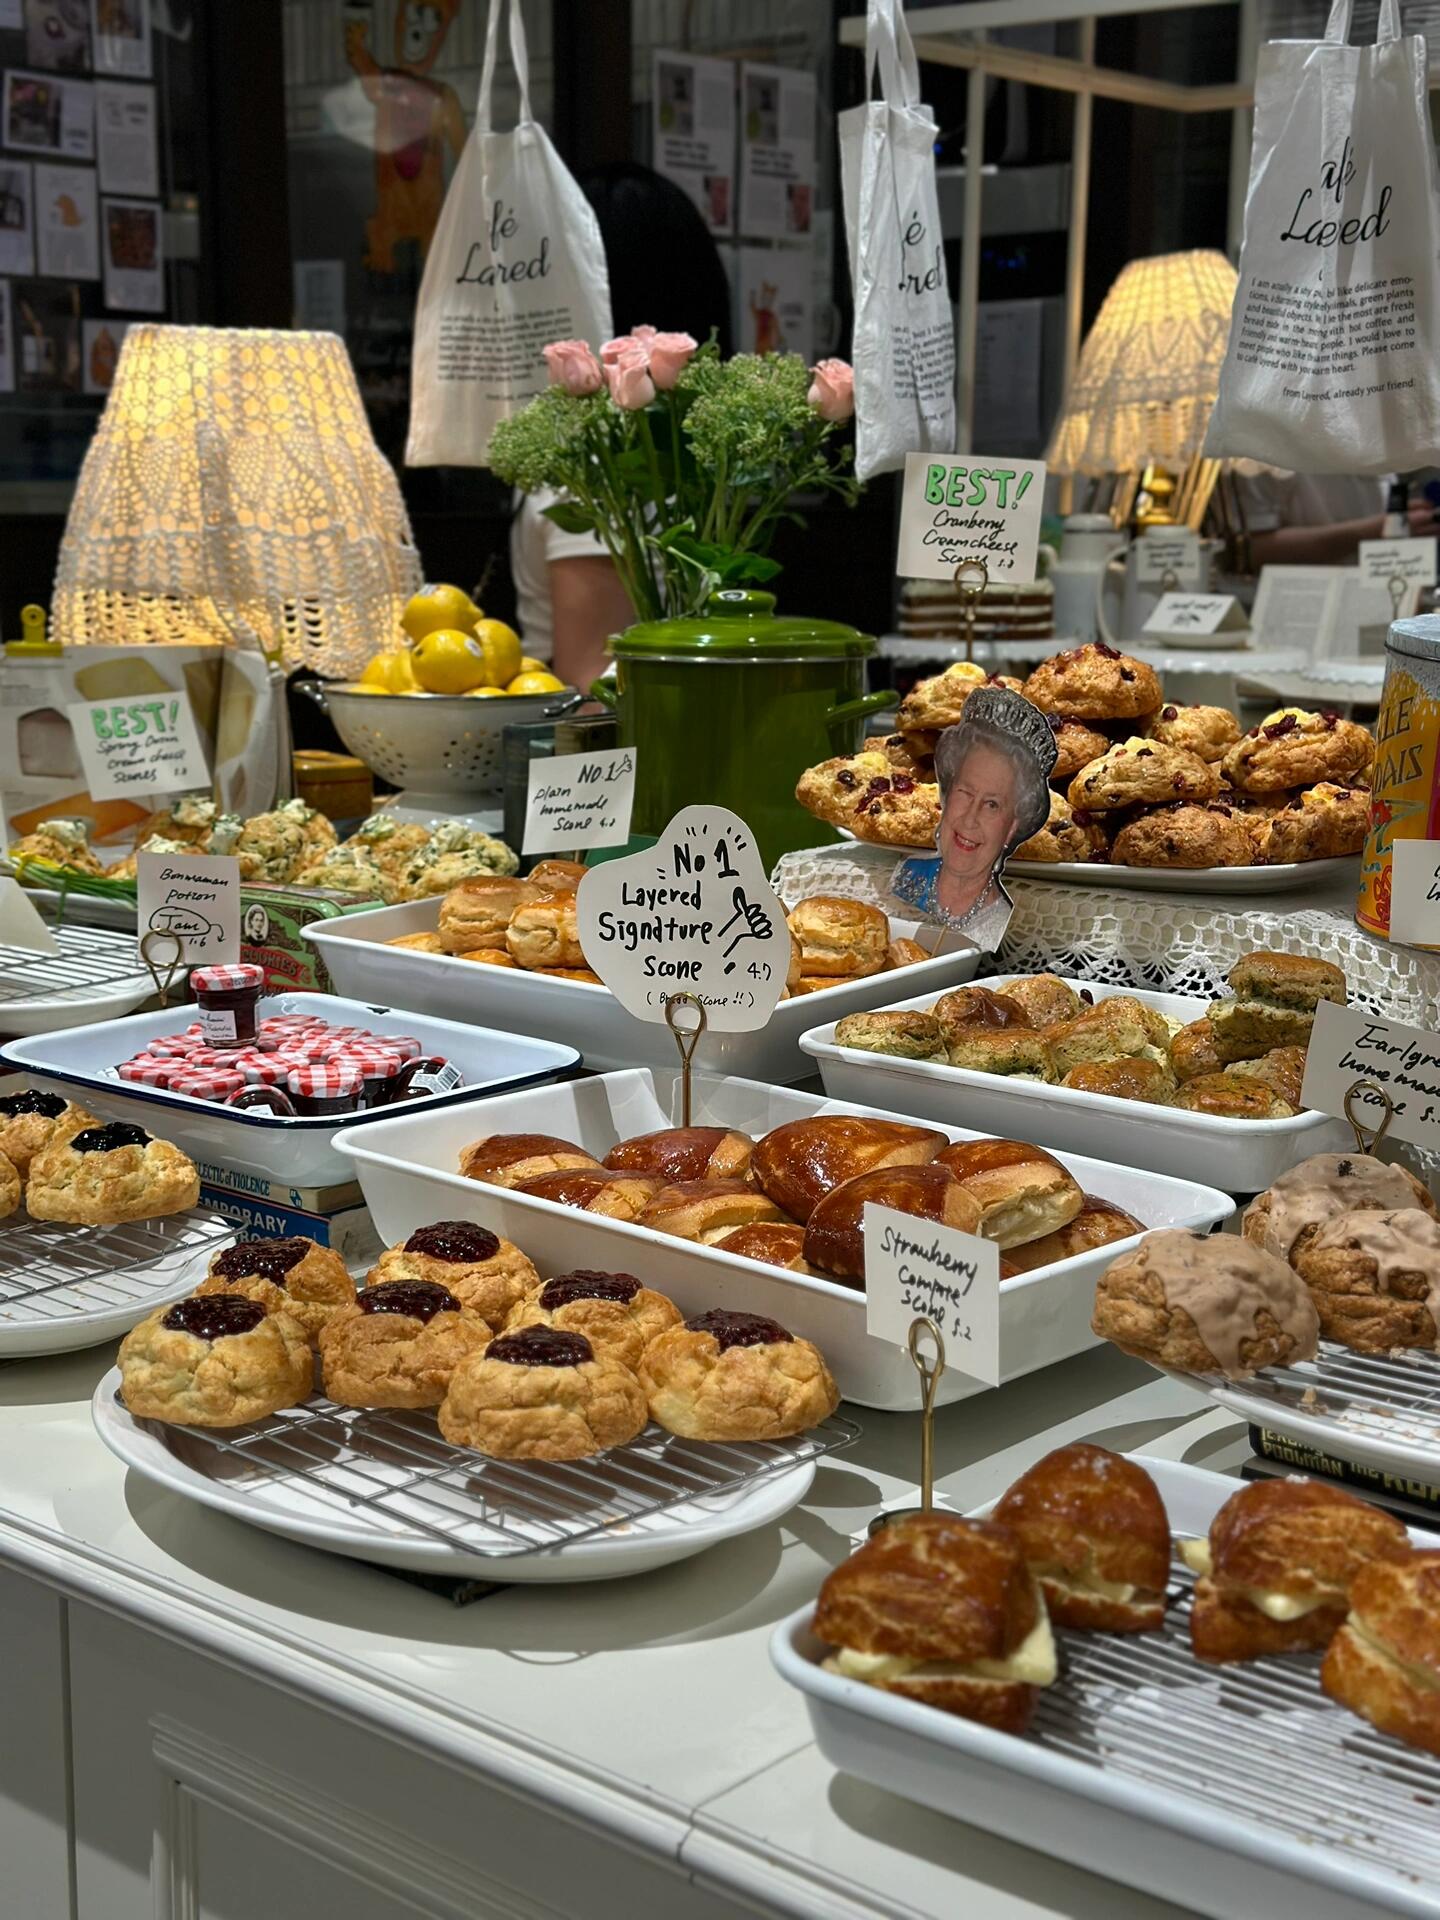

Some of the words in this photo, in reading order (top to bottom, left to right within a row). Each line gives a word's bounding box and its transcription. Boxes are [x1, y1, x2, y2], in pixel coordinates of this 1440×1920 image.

[1354, 280, 1387, 293] delicate
[1360, 294, 1384, 307] green
[1386, 288, 1414, 303] plants
[1374, 306, 1389, 315] are
[1390, 301, 1415, 313] fresh
[1349, 323, 1361, 333] hot
[1365, 318, 1392, 330] coffee
[1397, 313, 1415, 324] and
[1355, 331, 1380, 344] would
[1383, 328, 1402, 340] love
[1405, 326, 1415, 336] to
[1361, 345, 1388, 356] Please
[1390, 341, 1415, 351] come
[1283, 386, 1301, 397] from
[1334, 387, 1364, 399] already
[1366, 383, 1385, 395] your
[924, 463, 1034, 510] BEST!
[90, 700, 179, 739] BEST!
[673, 843, 705, 877] No
[714, 838, 740, 878] 1
[622, 880, 702, 911] Layered
[599, 911, 713, 951] Signature
[643, 955, 703, 981] Scone
[747, 962, 772, 981] 4.7
[233, 1173, 271, 1196] VIOLENCE
